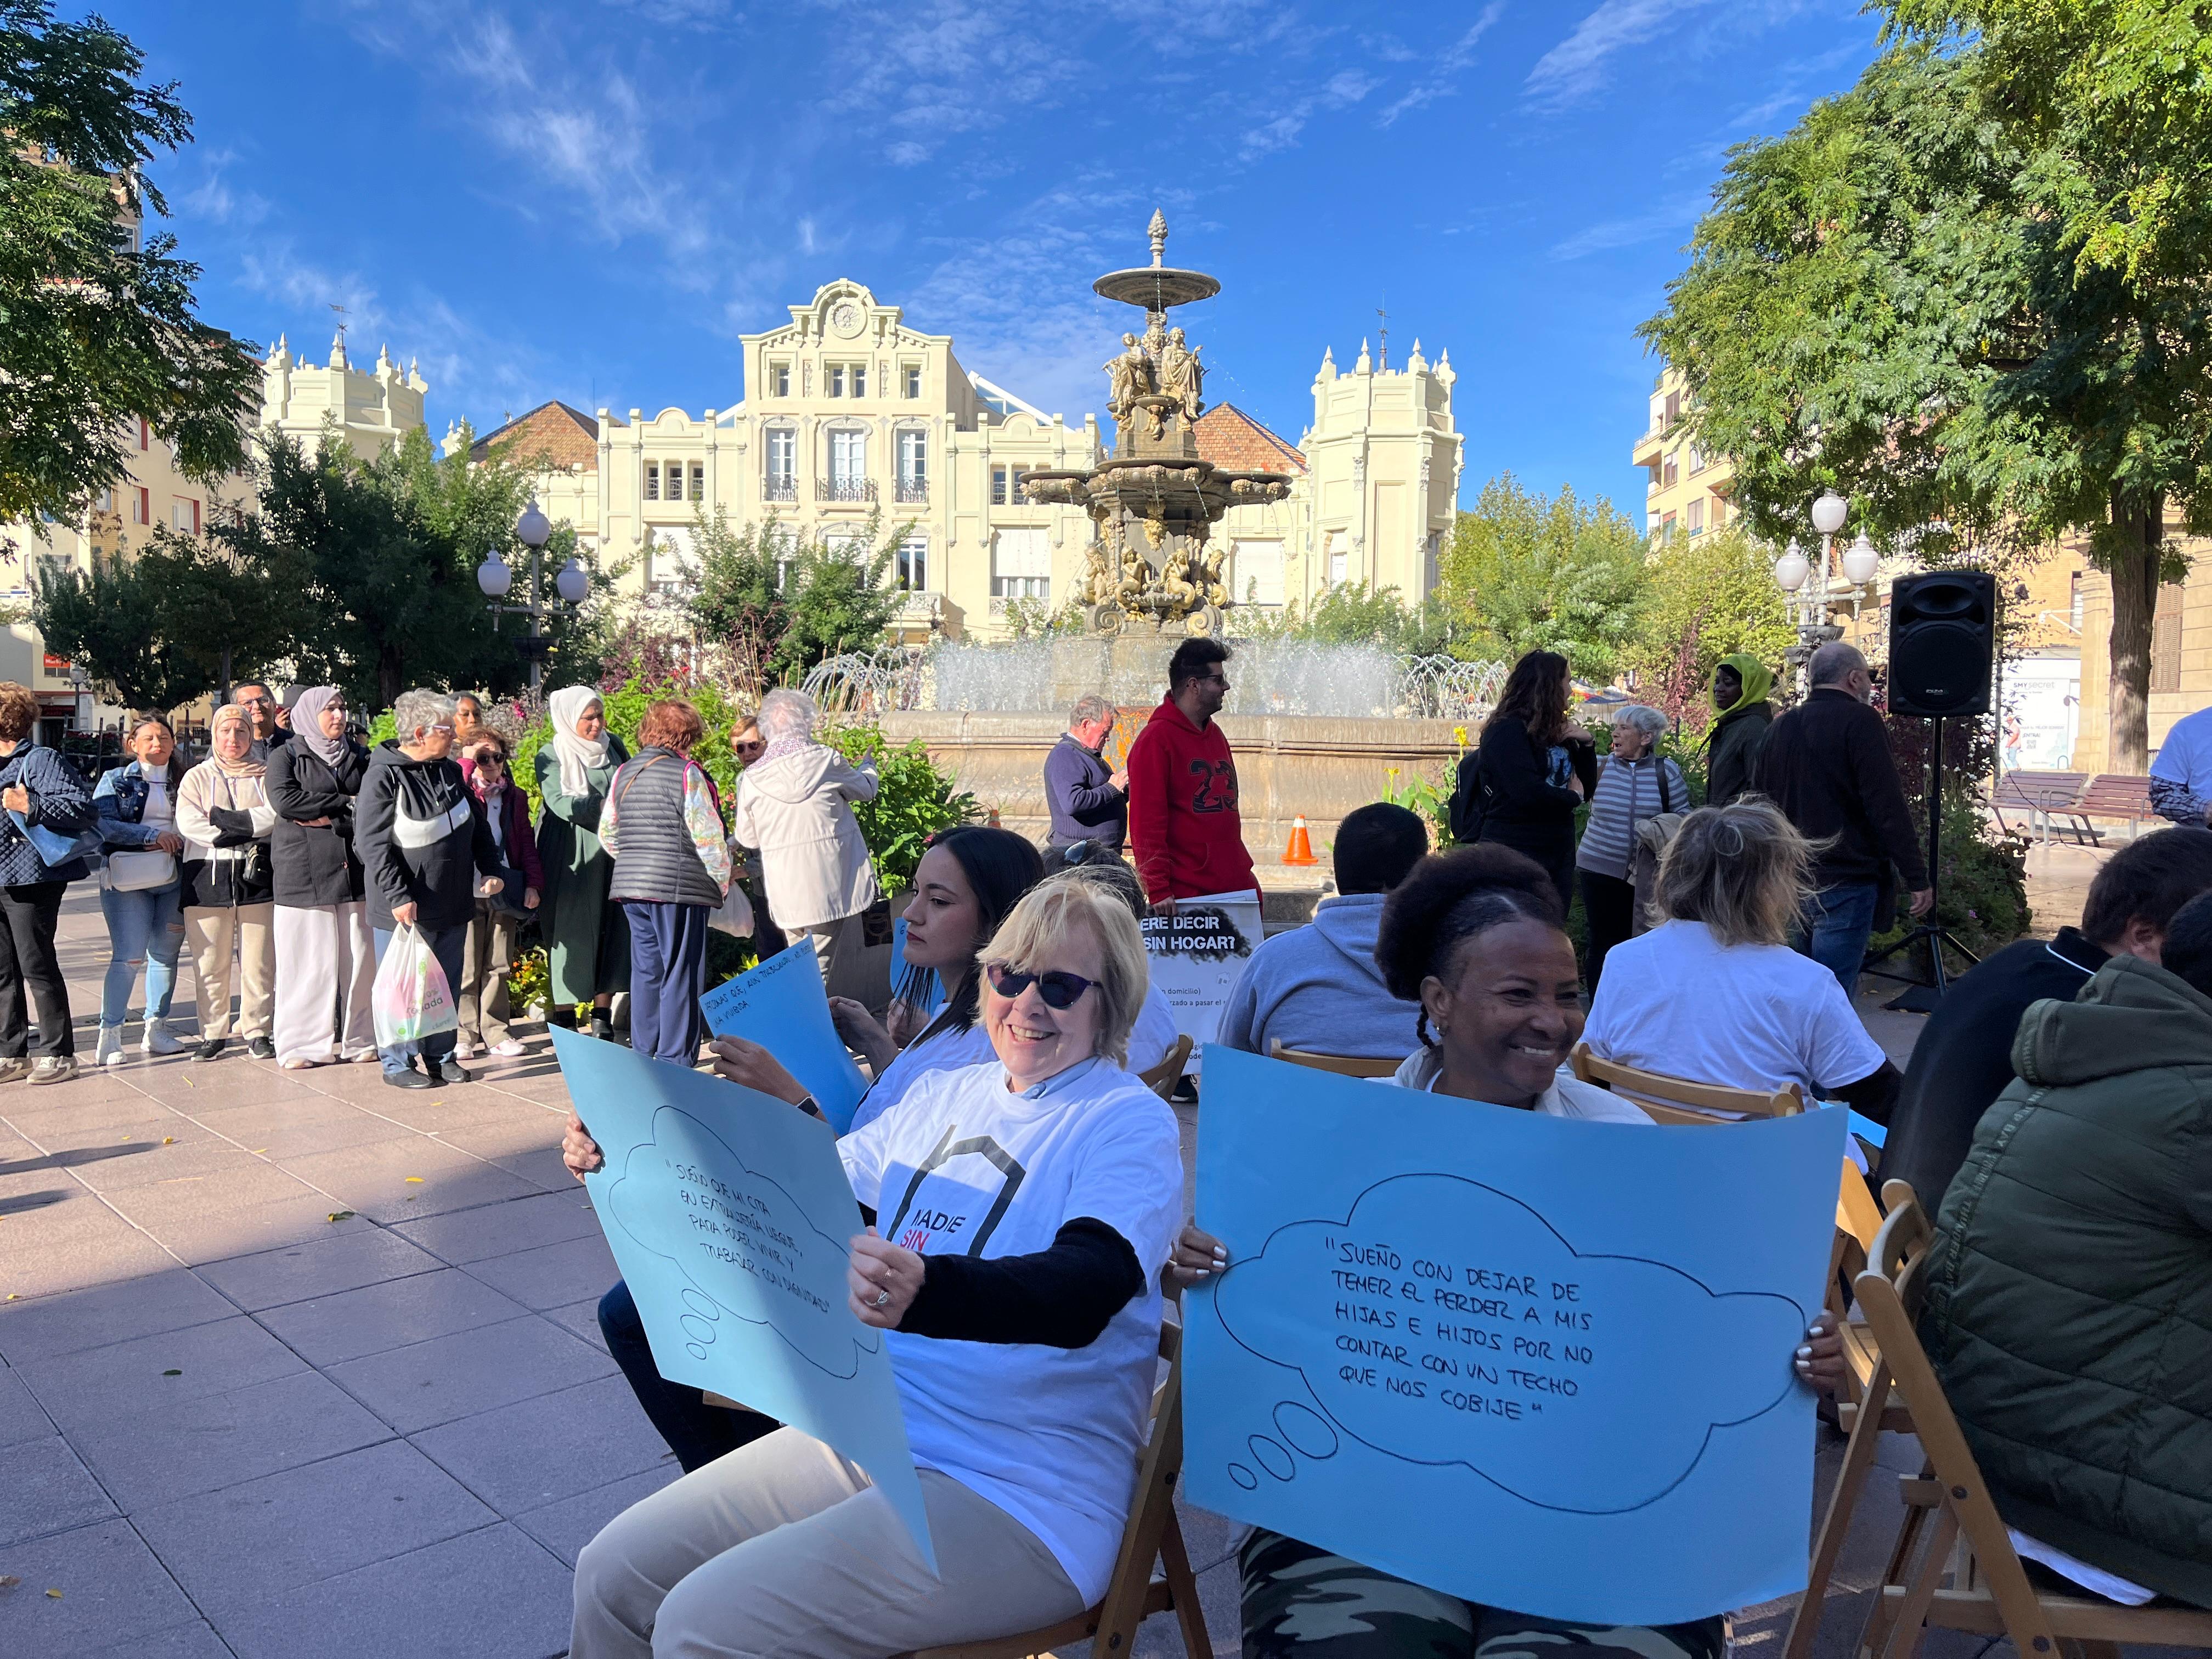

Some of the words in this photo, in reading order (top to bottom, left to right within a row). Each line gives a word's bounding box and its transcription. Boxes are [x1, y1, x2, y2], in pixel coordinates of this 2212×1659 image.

[1140, 917, 1169, 931] ERE
[1173, 916, 1220, 930] DECIR
[1143, 936, 1166, 950] SIN
[1170, 936, 1235, 950] HOGAR?
[1168, 987, 1201, 996] domicilio)
[681, 1190, 697, 1206] EN
[711, 1179, 731, 1199] QUE
[732, 1189, 746, 1205] MI
[748, 1195, 771, 1217] CITA
[689, 1214, 722, 1235] PARA
[723, 1223, 755, 1250] PODER
[755, 1239, 785, 1267] VIVIR
[785, 1255, 793, 1273] Y
[900, 1229, 930, 1251] SIN
[700, 1243, 759, 1278] TRABAJAR
[761, 1268, 783, 1288] CON
[1413, 1260, 1453, 1282] CON
[1466, 1268, 1539, 1297] DEJAR
[1552, 1282, 1580, 1301] DE
[1331, 1269, 1393, 1299] TEMER
[1401, 1282, 1425, 1303] EL
[1434, 1288, 1514, 1321] PERDER
[1524, 1307, 1541, 1325] A
[1555, 1310, 1593, 1330] MIS
[1335, 1301, 1396, 1328] HIJAS
[1409, 1317, 1422, 1335] E
[1437, 1322, 1502, 1350] HIJOS
[1514, 1337, 1555, 1361] POR
[1565, 1345, 1593, 1364] NO
[1335, 1335, 1413, 1367] CONTAR
[1421, 1353, 1458, 1376] CON
[1467, 1363, 1498, 1385] UN
[1506, 1369, 1578, 1397] TECHO
[1339, 1365, 1377, 1388] QUE
[1386, 1378, 1426, 1398] NOS
